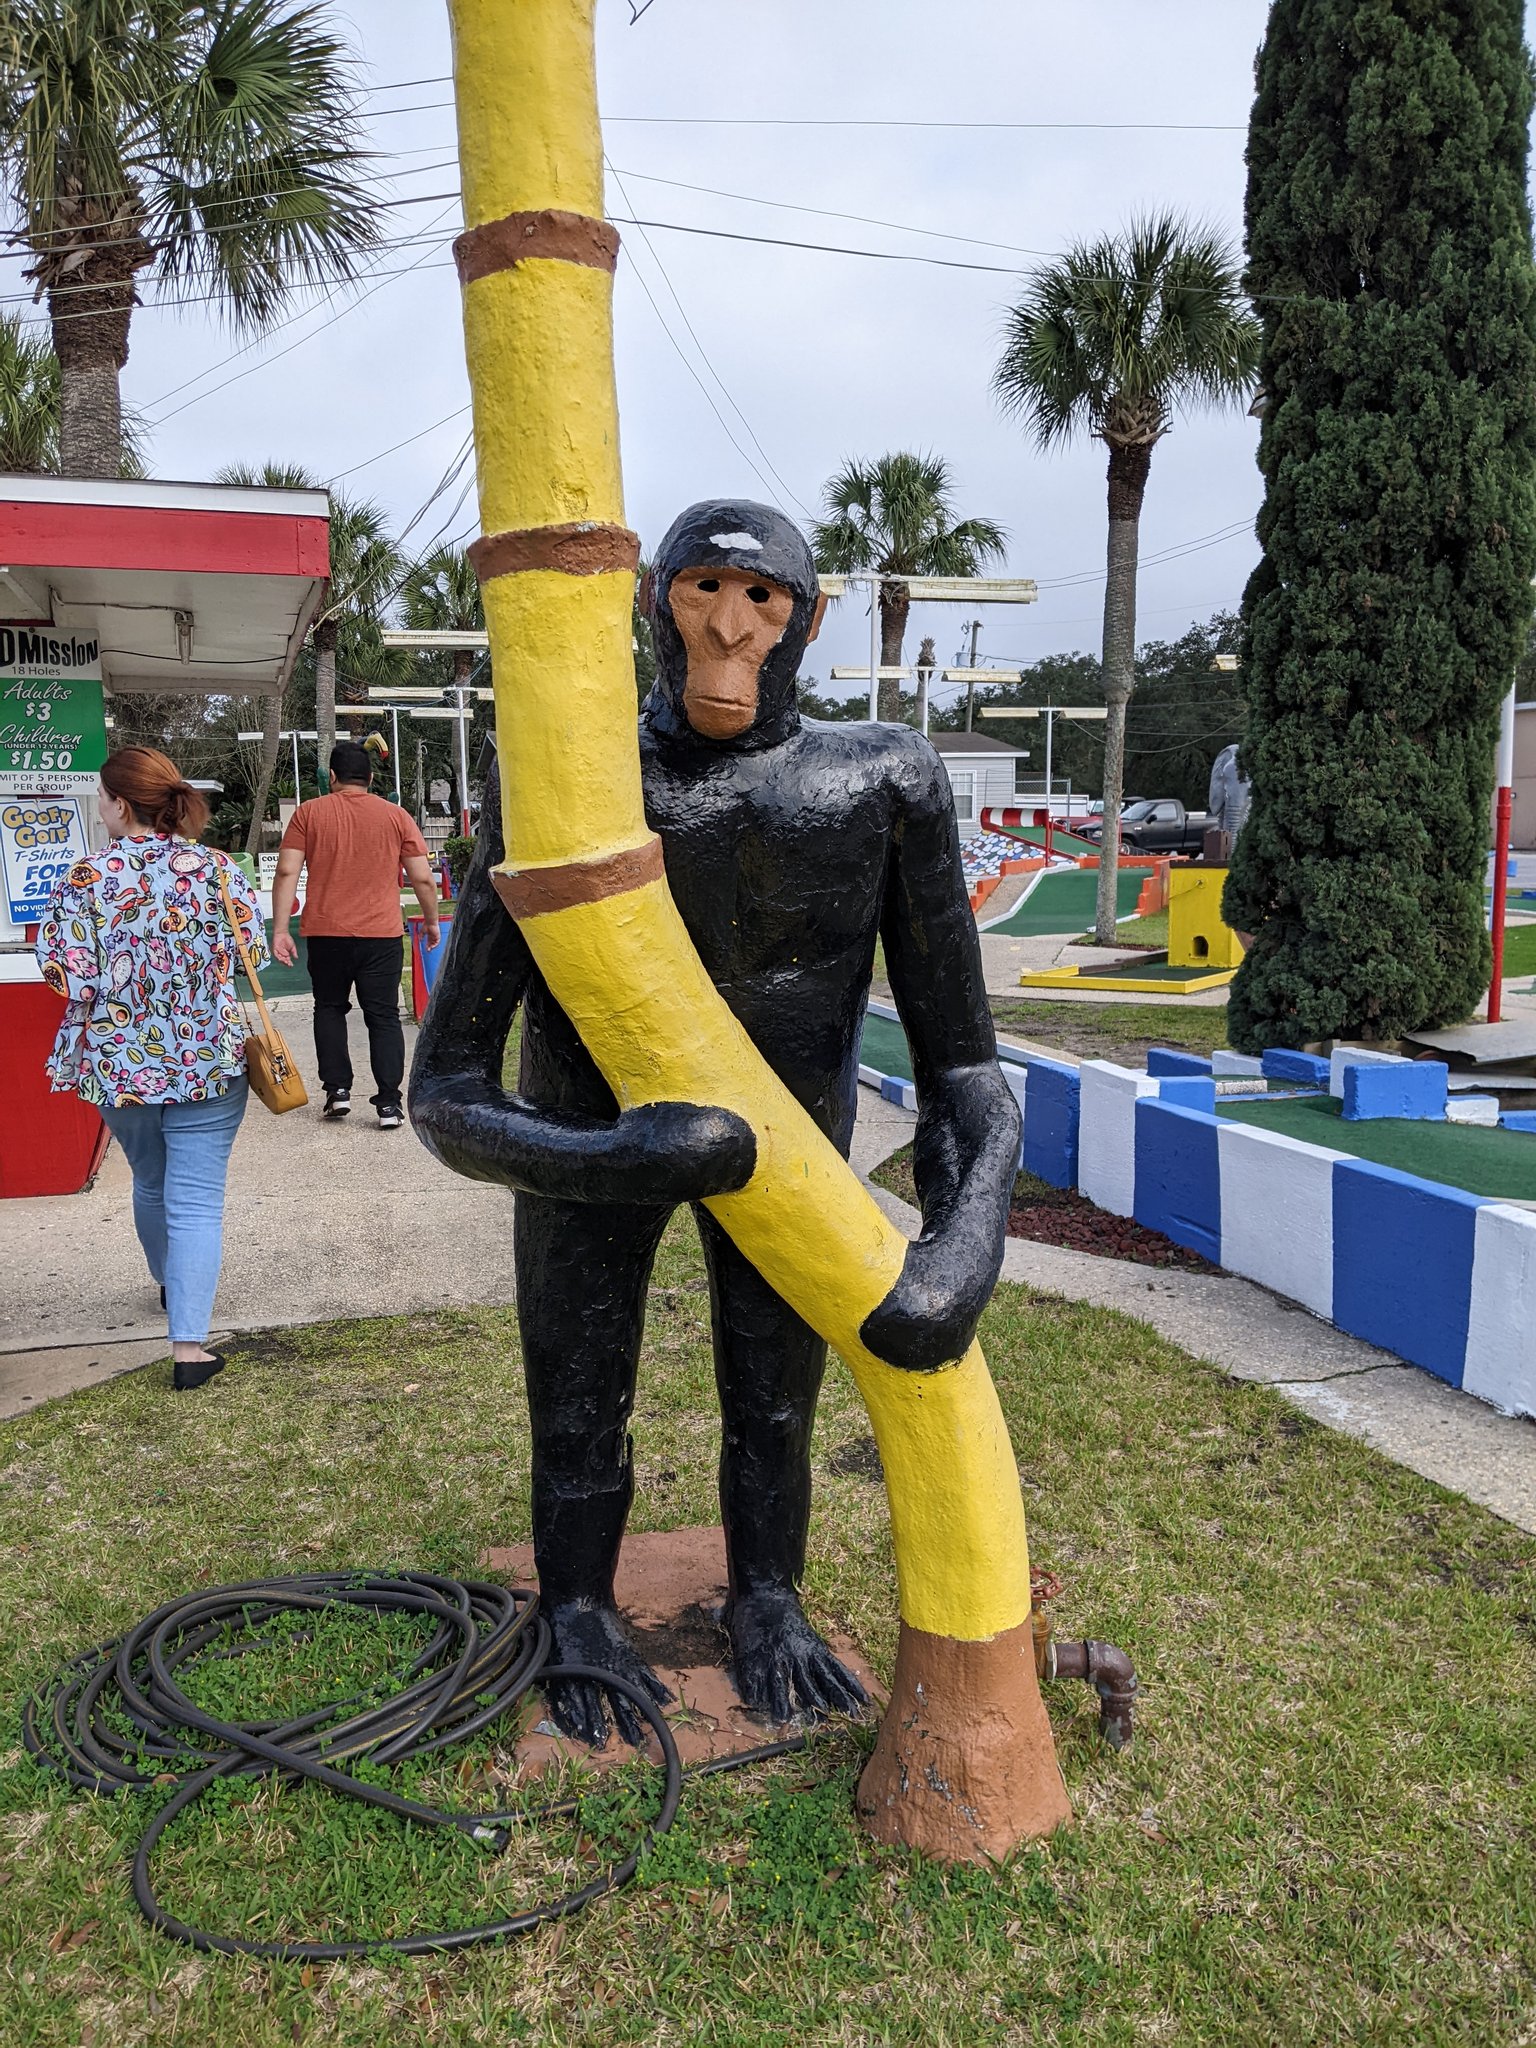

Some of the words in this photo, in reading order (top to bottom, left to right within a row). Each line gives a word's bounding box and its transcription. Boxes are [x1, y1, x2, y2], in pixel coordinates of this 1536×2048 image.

[12, 666, 26, 675] 18
[29, 667, 61, 676] Holes
[3, 680, 73, 700] Adults
[26, 702, 52, 721] $3
[0, 724, 82, 744] Children
[11, 751, 72, 770] $1.50
[35, 783, 73, 791] GROUP
[47, 774, 95, 783] PERSONS
[14, 847, 75, 862] T-Shirts
[22, 880, 53, 897] SA
